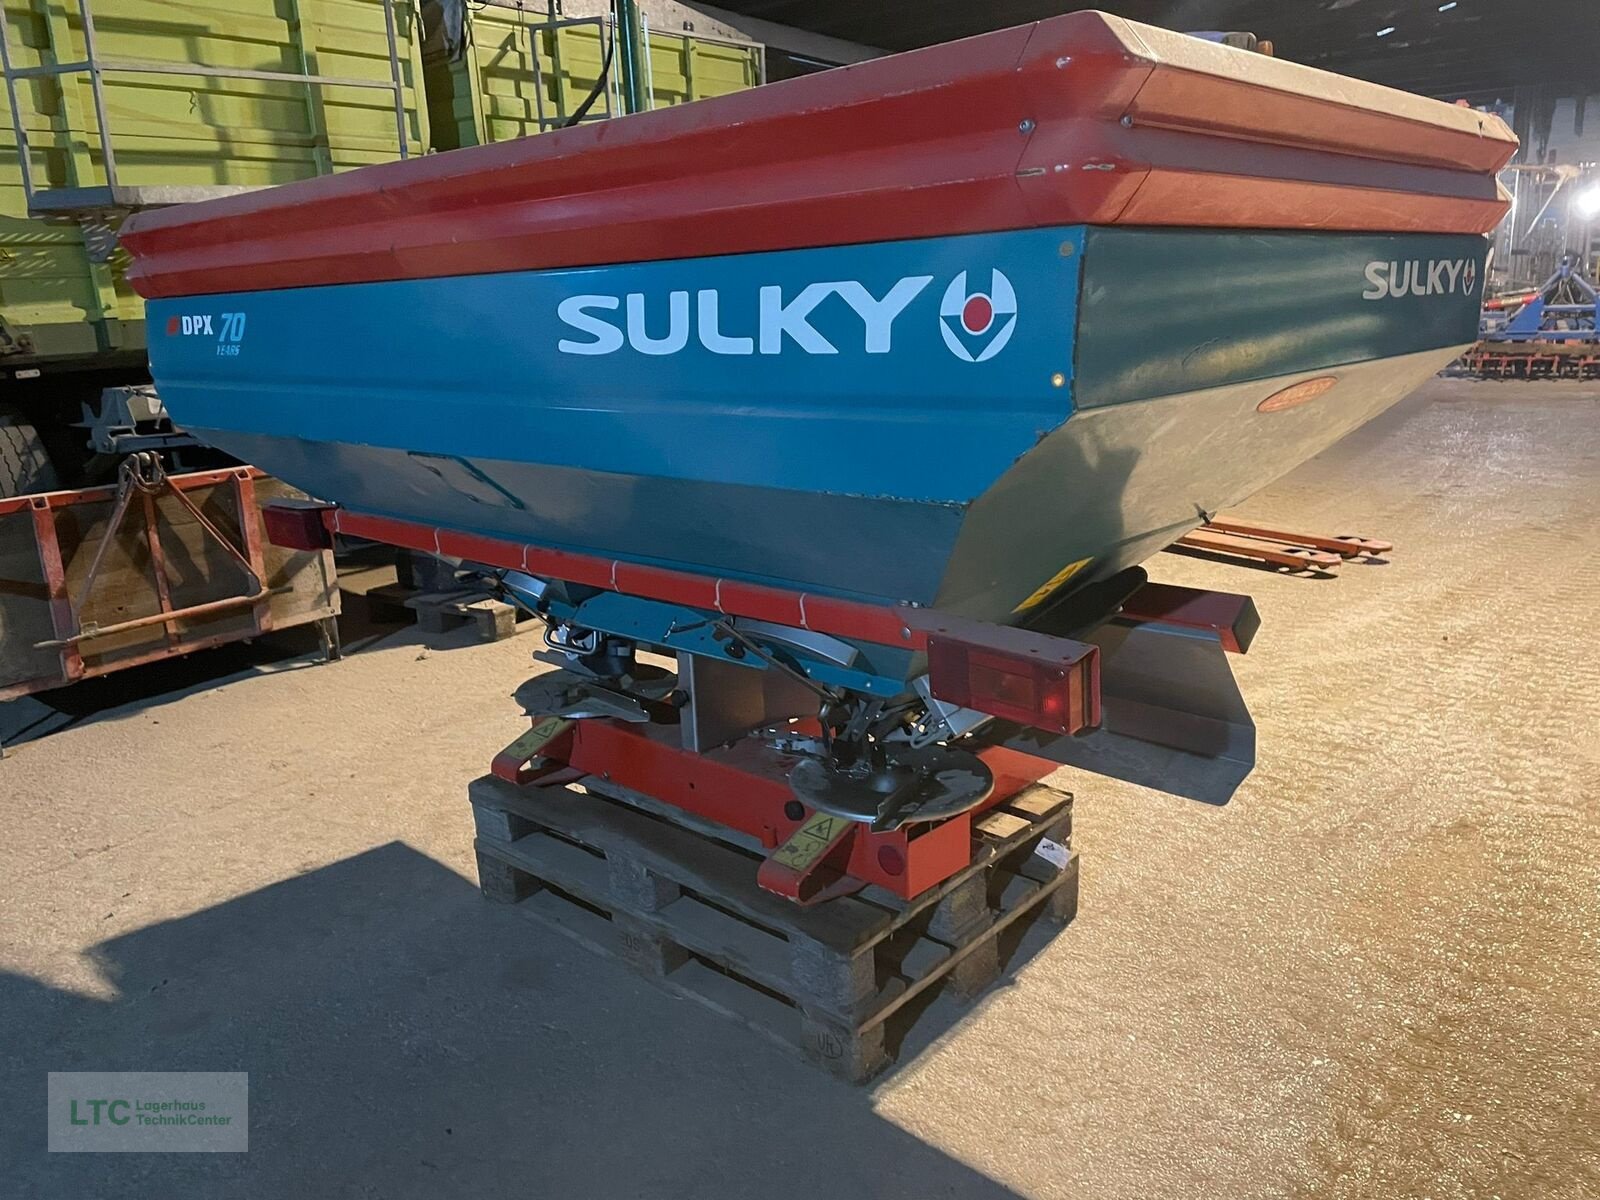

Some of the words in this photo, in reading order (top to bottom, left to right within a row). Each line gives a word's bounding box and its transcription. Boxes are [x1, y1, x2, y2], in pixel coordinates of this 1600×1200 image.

[1362, 260, 1463, 300] SULKY
[181, 315, 214, 335] DPX
[218, 312, 247, 342] 70
[557, 275, 934, 356] SULKY
